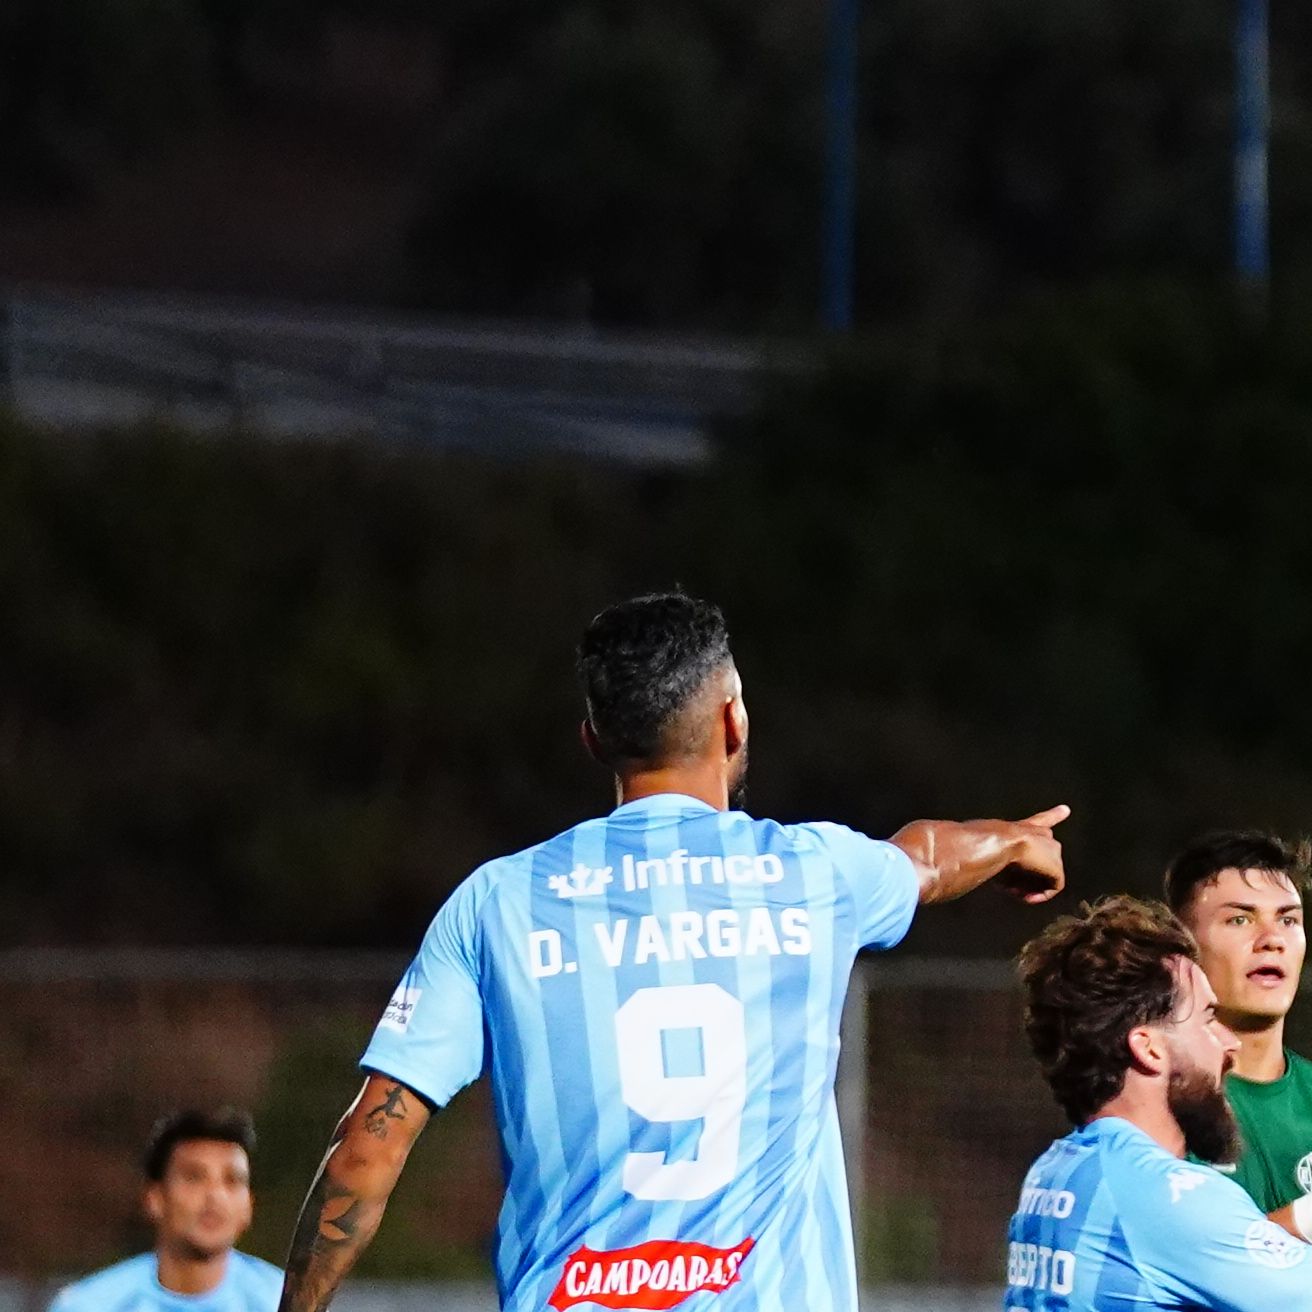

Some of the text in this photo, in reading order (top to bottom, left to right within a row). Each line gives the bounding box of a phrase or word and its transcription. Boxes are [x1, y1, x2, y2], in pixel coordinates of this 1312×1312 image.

[622, 849, 785, 892] Infrico
[528, 907, 812, 979] D. VARGAS
[614, 983, 747, 1201] 9
[565, 1252, 743, 1298] CAMPOARAS
